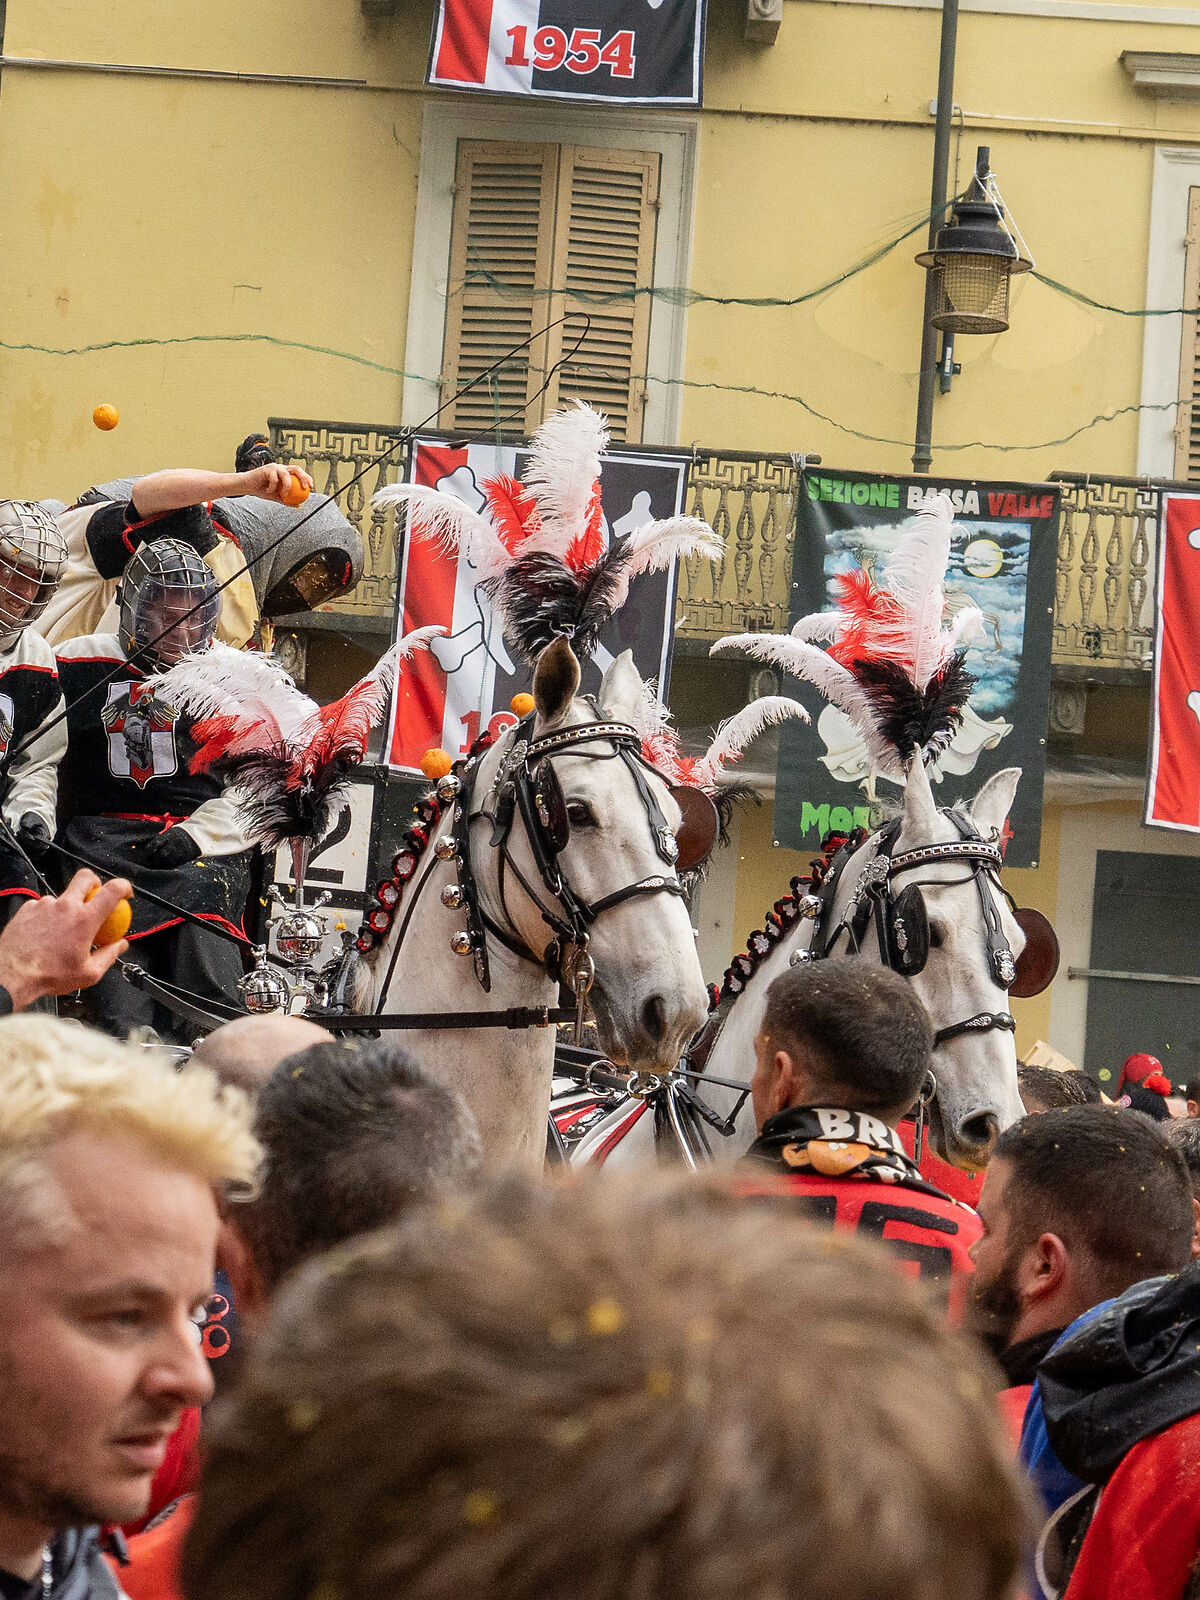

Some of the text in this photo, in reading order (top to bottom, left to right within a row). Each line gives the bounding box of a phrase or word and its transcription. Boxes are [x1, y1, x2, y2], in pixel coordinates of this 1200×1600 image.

[505, 25, 636, 79] 1954
[807, 476, 899, 508] SEZIONE
[987, 492, 1053, 518] VALLE
[289, 803, 352, 884] 2
